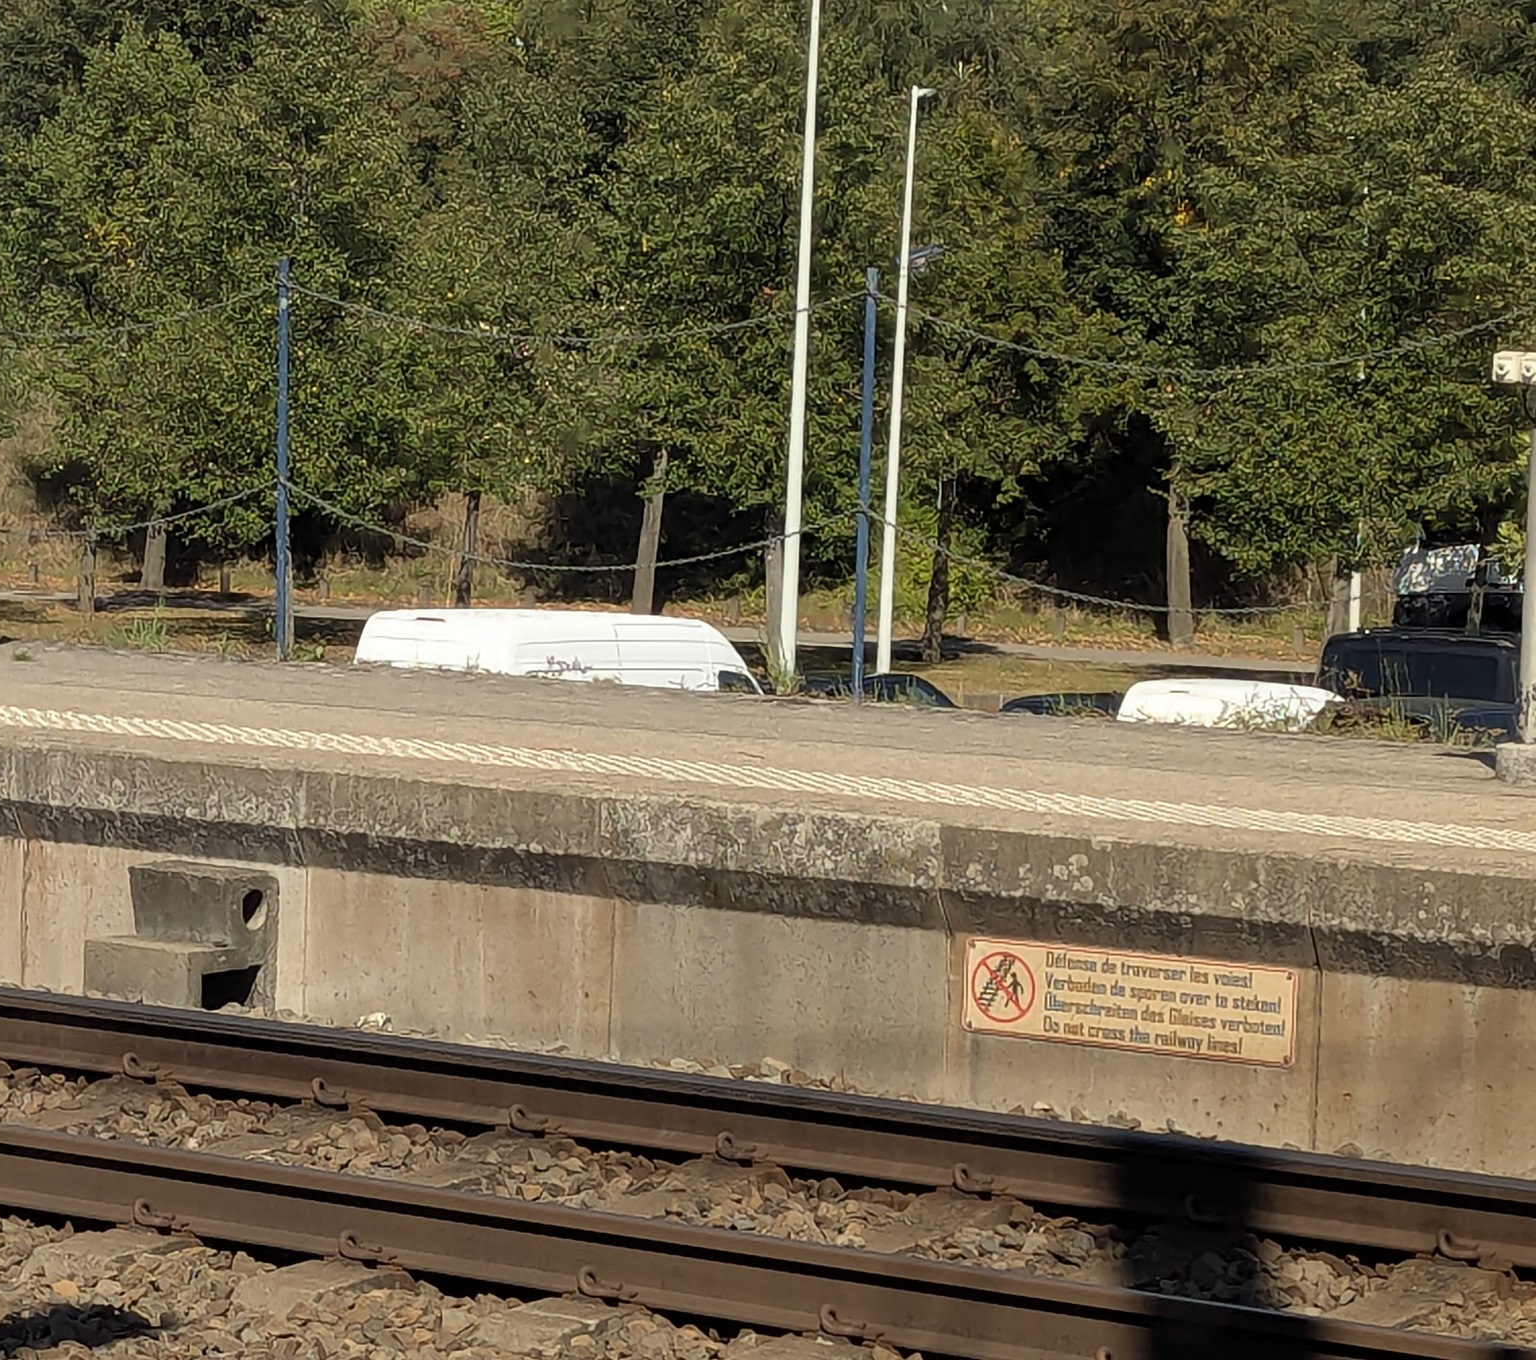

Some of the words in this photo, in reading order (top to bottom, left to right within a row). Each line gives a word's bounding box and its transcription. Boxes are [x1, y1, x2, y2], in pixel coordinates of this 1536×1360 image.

[1045, 951, 1097, 973] Défense
[1101, 957, 1117, 974] de
[1121, 961, 1186, 982] traverser
[1190, 965, 1209, 984] les
[1213, 971, 1252, 989] voies!
[1045, 971, 1107, 995] Verboden
[1110, 979, 1126, 997] de
[1129, 986, 1177, 1003] sporen
[1179, 991, 1211, 1006] over
[1215, 992, 1228, 1009] te
[1232, 994, 1282, 1014] steken!
[1043, 1015, 1060, 1034] Do
[1063, 1022, 1084, 1037] not
[1088, 1026, 1125, 1041] cross
[1129, 1024, 1150, 1044] the
[1154, 1030, 1203, 1054] railway
[1206, 1032, 1243, 1055] lines!
[1169, 1007, 1217, 1029] Gleises
[1220, 1015, 1285, 1037] verboten!
